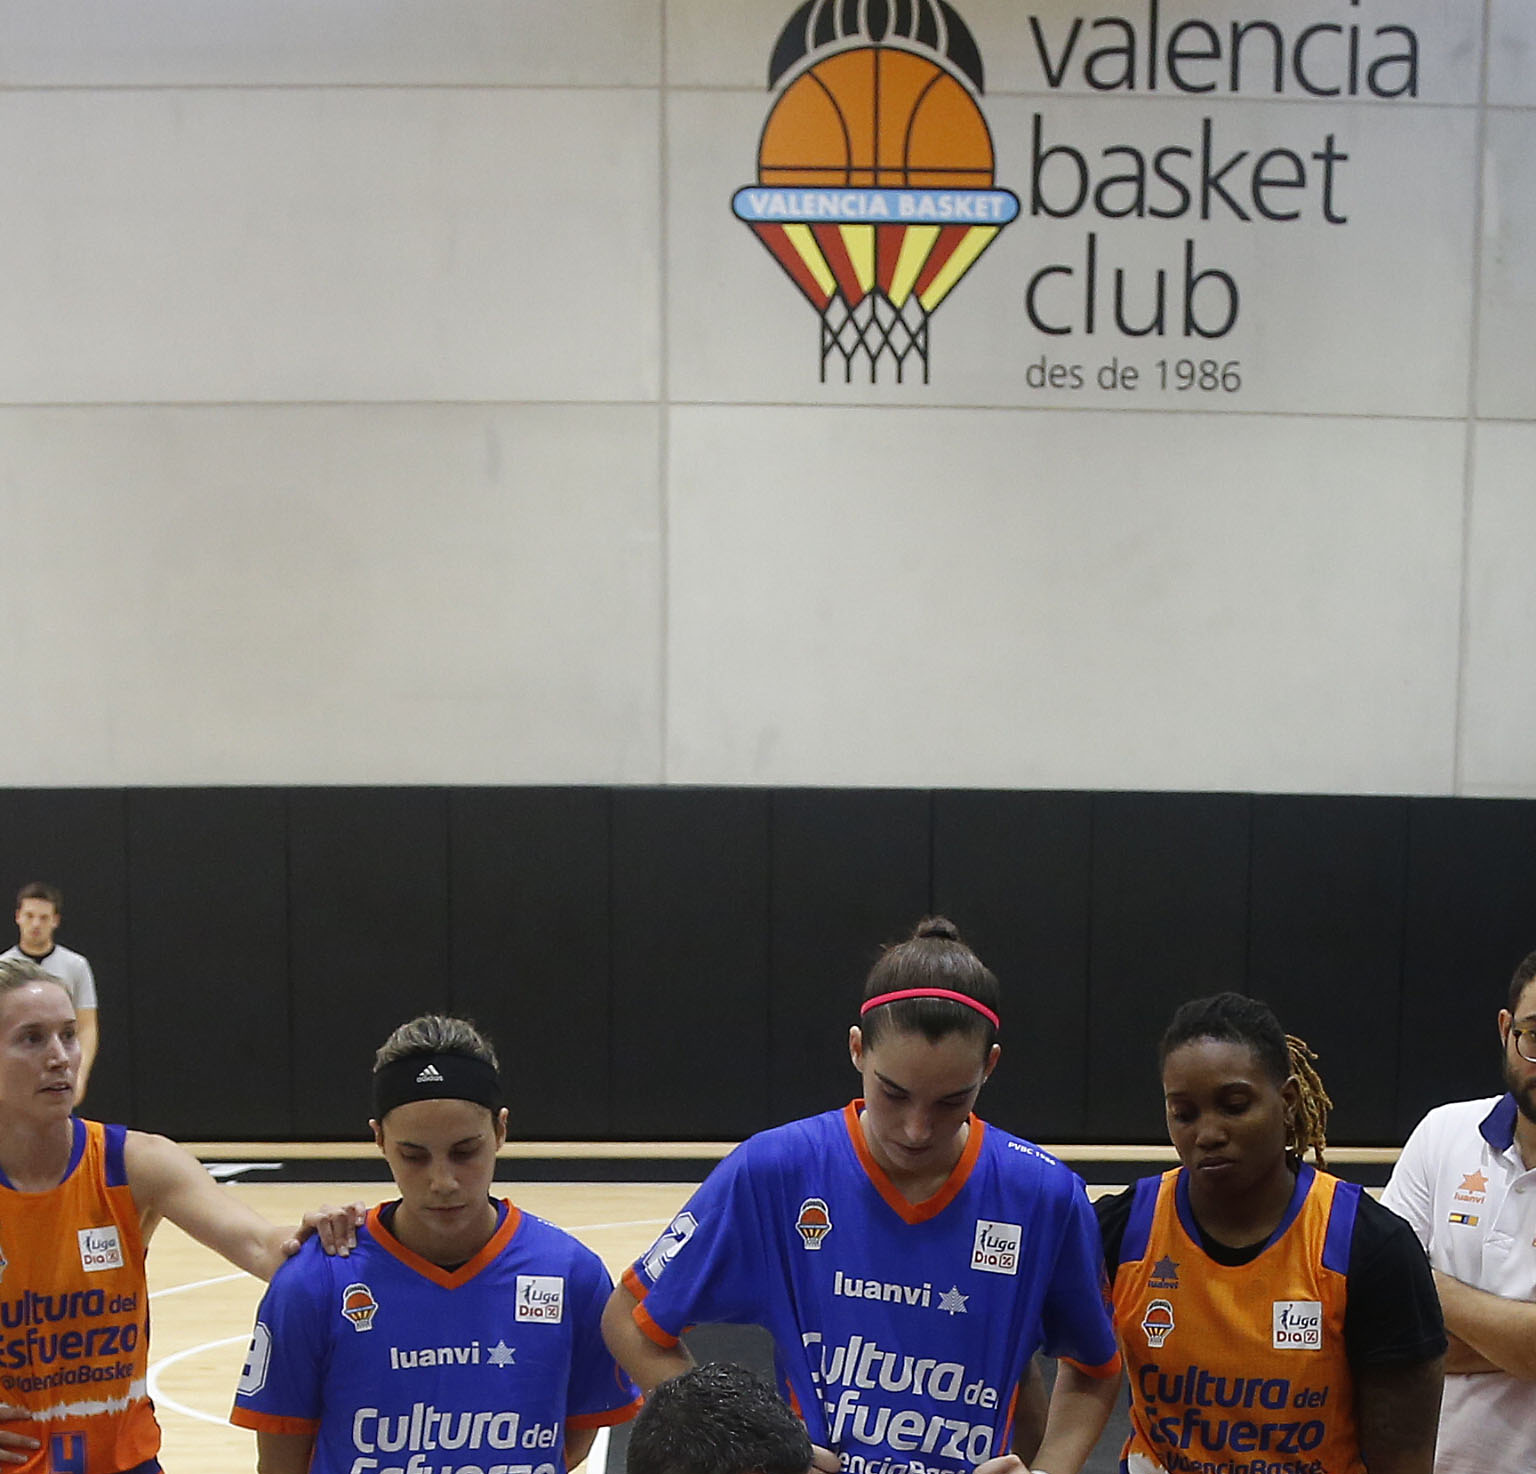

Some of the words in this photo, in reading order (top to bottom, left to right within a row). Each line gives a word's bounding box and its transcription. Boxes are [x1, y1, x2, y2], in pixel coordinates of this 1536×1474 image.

[1028, 0, 1421, 98] valencia
[1031, 112, 1350, 226] basket
[749, 192, 888, 218] VALENCIA
[898, 193, 1005, 219] BASKET
[1024, 232, 1242, 340] club
[1025, 355, 1085, 391] des
[1097, 357, 1140, 392] de
[1156, 359, 1243, 393] 1986
[986, 1233, 1016, 1253] Liga
[108, 1292, 138, 1314] del
[531, 1289, 561, 1306] Liga
[833, 1271, 933, 1309] luanvi
[1289, 1314, 1319, 1330] Liga
[390, 1341, 481, 1370] luanvi
[802, 1331, 965, 1402] Cultura
[1138, 1364, 1291, 1410] Cultura
[1293, 1386, 1329, 1409] del
[351, 1401, 520, 1454] Cultura
[522, 1421, 559, 1450] del
